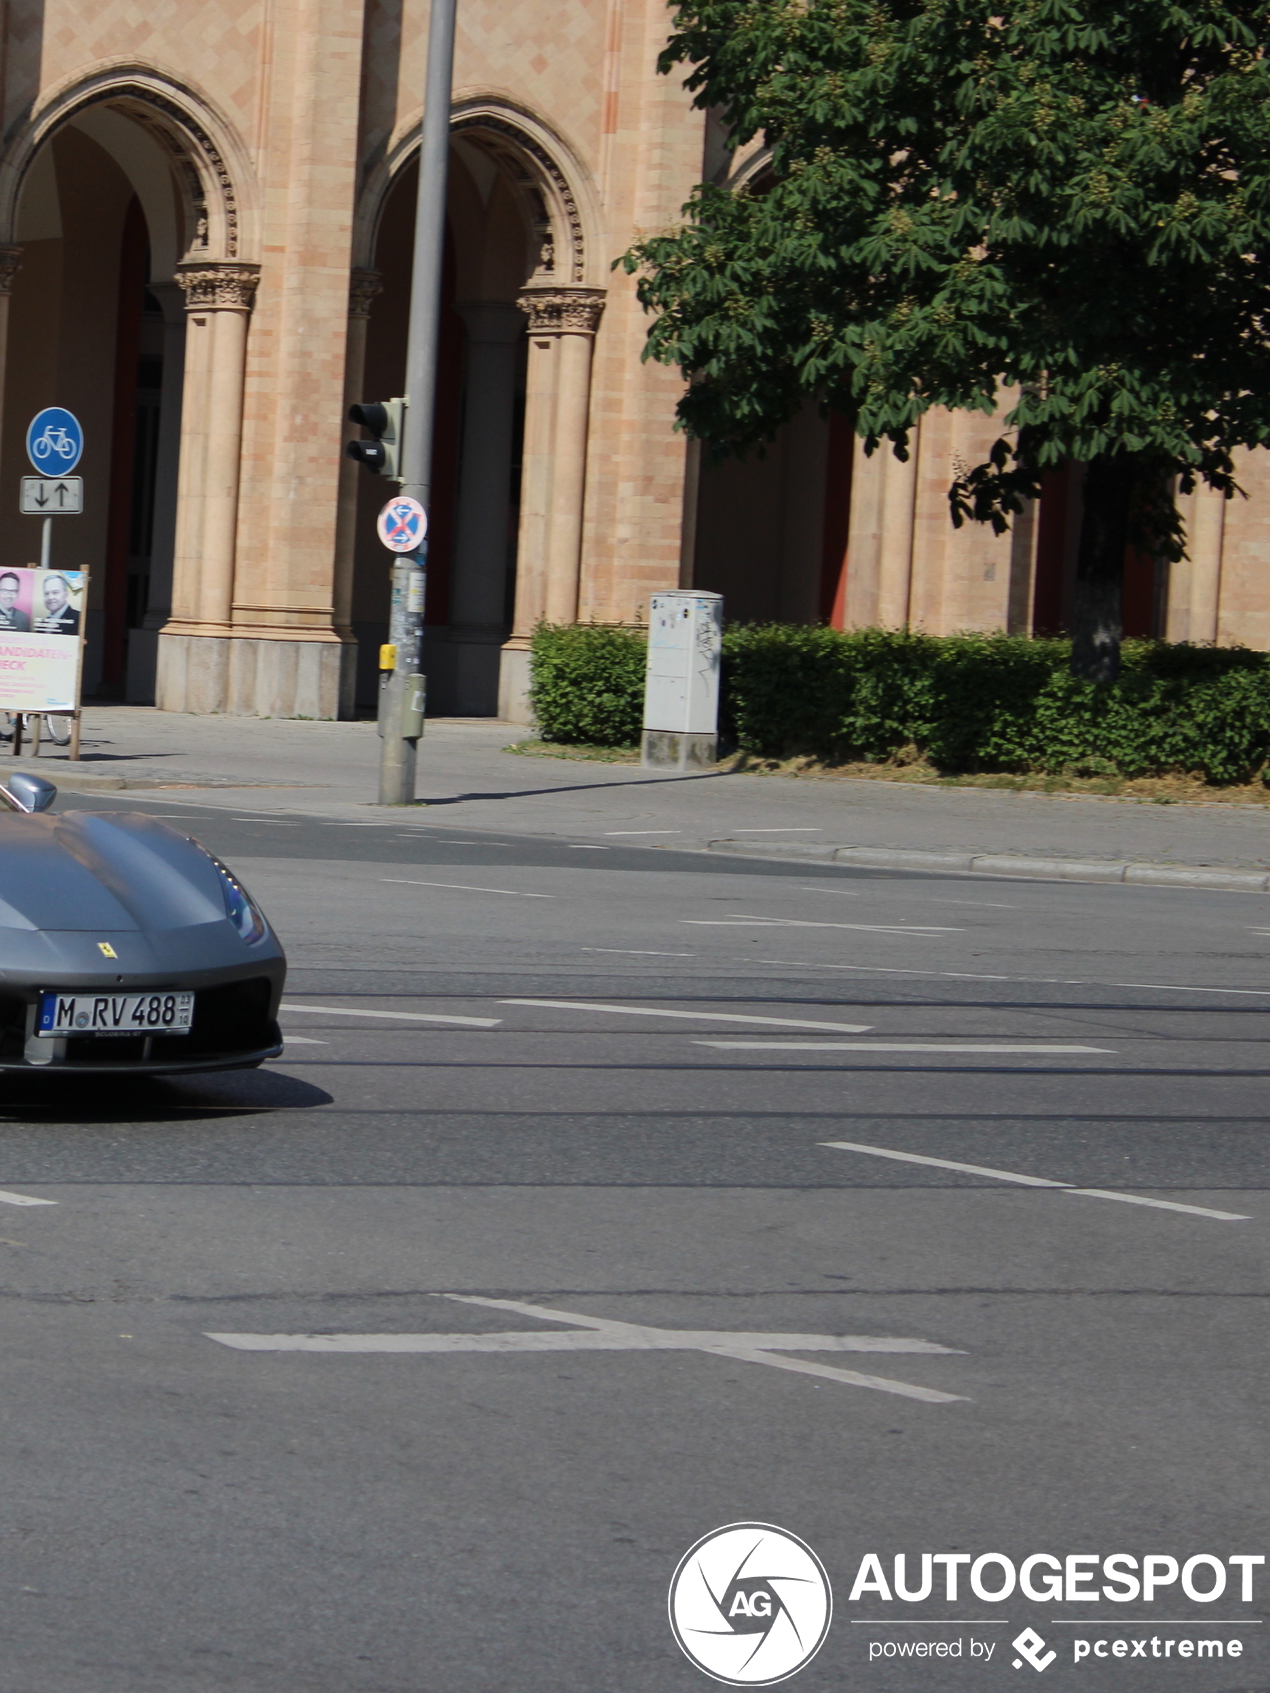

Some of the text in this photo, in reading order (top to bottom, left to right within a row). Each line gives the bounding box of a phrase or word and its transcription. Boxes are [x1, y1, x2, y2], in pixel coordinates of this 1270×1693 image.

[43, 1015, 50, 1024] D
[57, 995, 176, 1027] M RV 488
